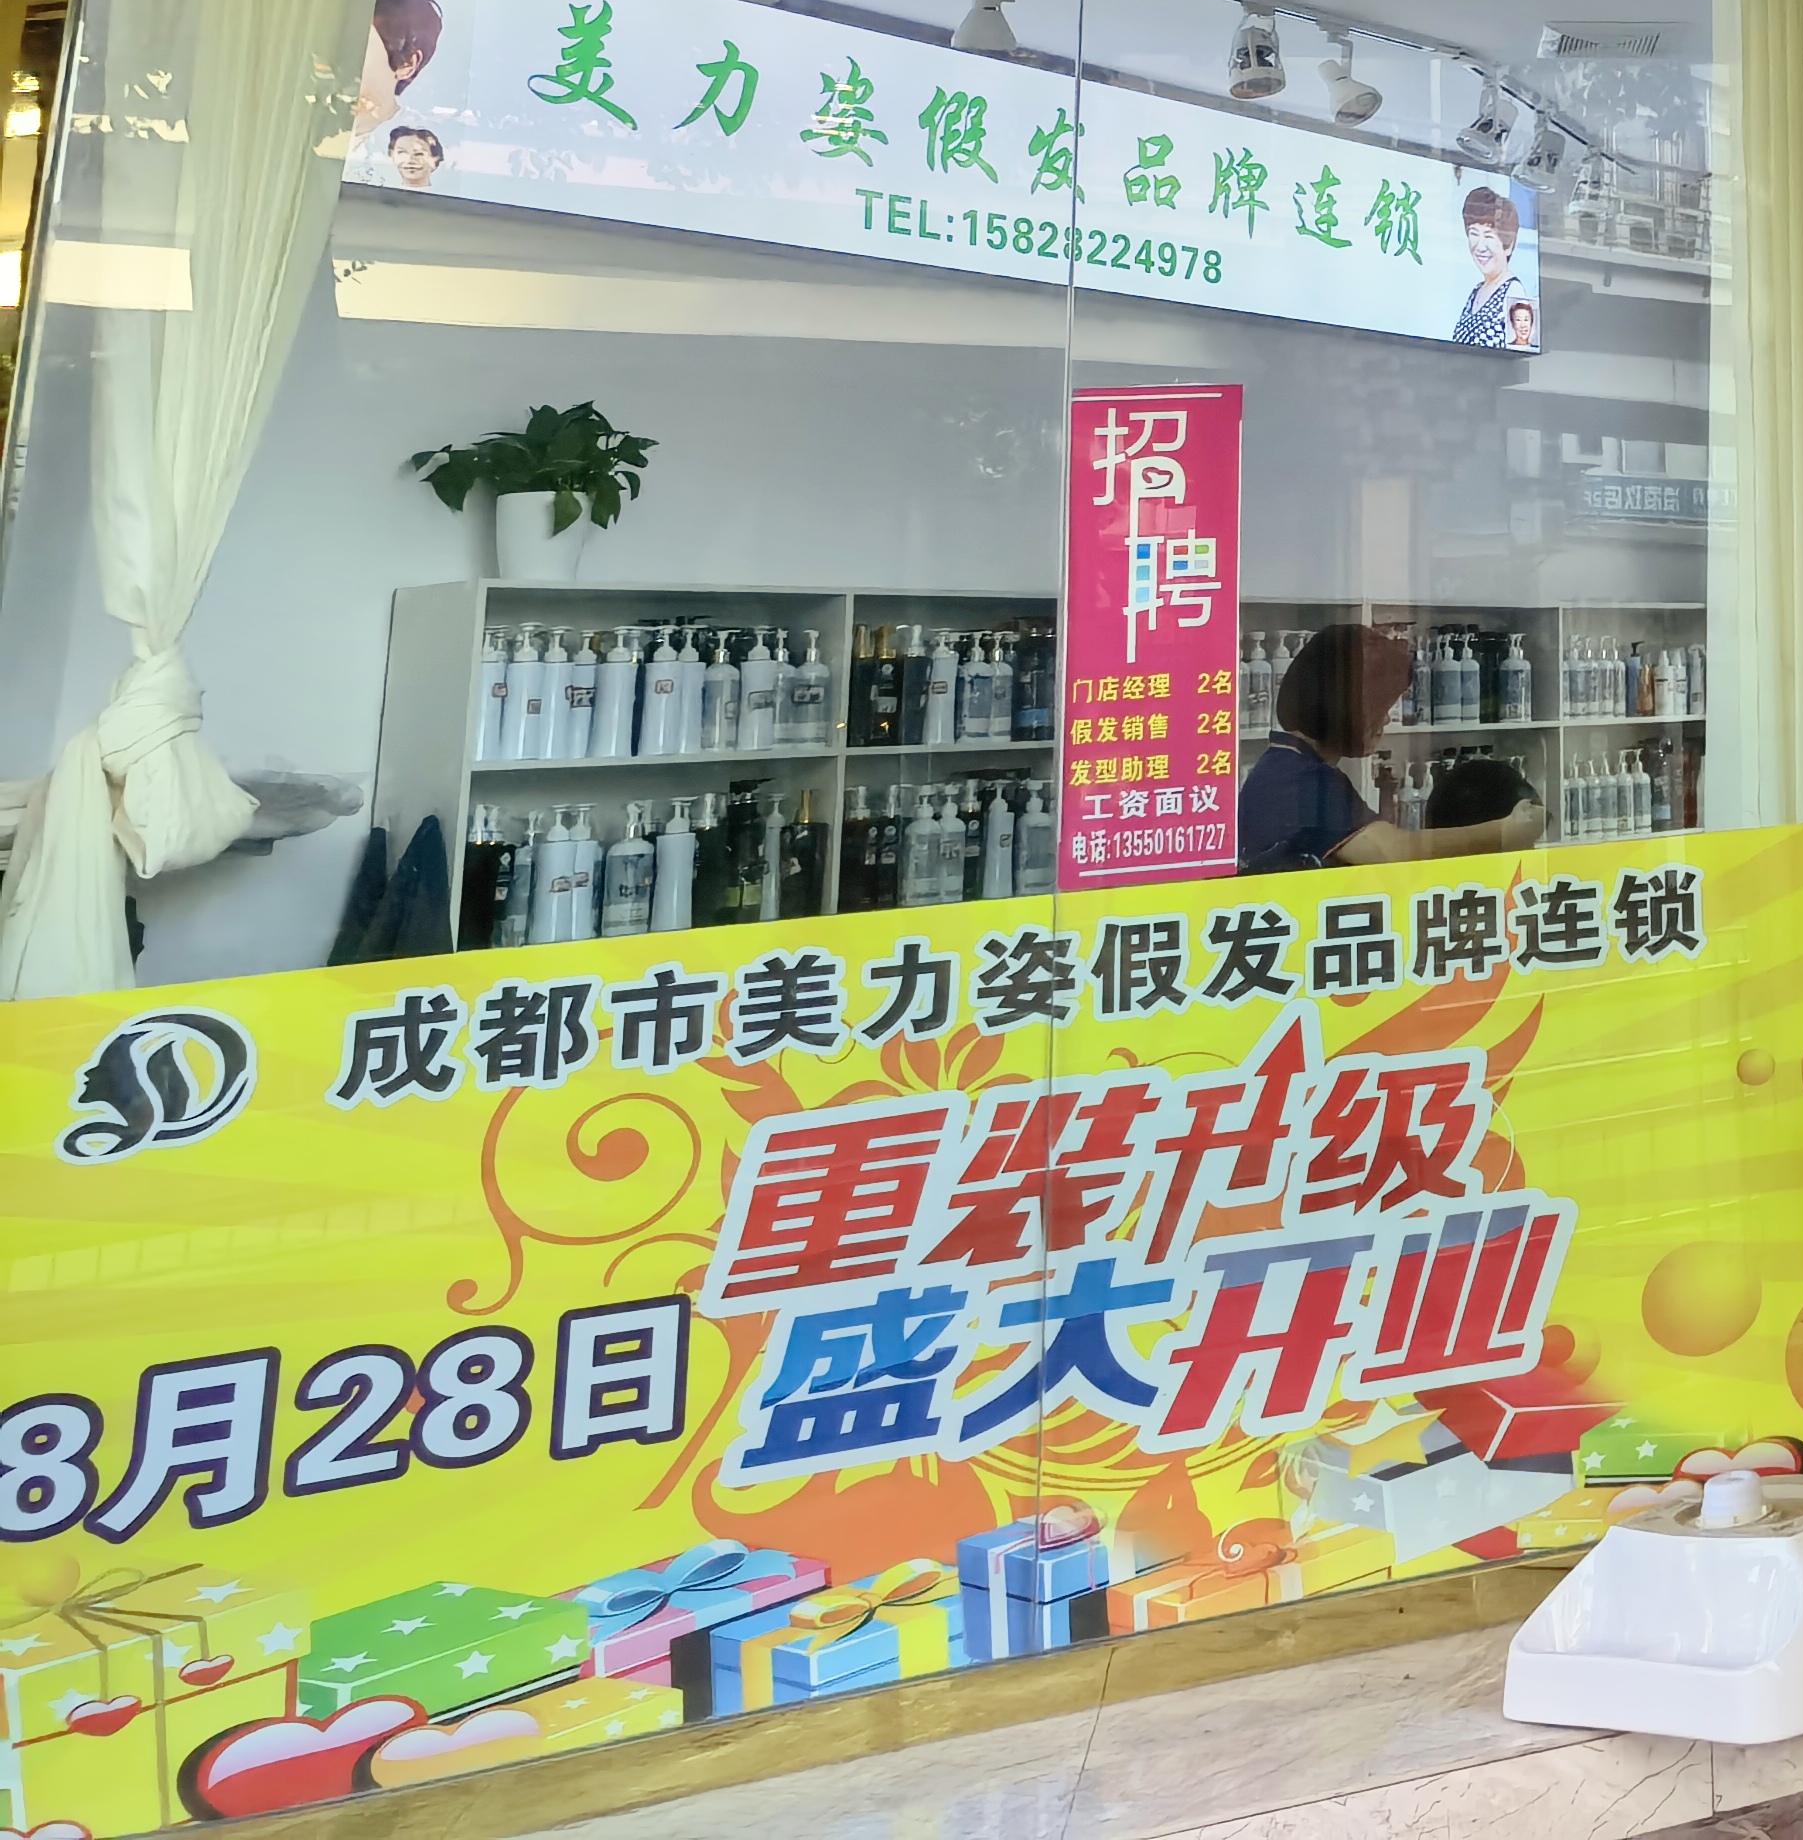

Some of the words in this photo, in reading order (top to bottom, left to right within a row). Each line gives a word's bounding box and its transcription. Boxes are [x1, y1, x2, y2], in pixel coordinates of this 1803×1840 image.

[527, 0, 1423, 265] 美力姿假发品牌连锁
[1093, 407, 1222, 664] 招聘
[1069, 754, 1170, 786] 发型助理
[1196, 749, 1232, 776] 2名
[1070, 713, 1169, 745] 假发销售
[1196, 709, 1232, 735] 2名
[1072, 673, 1171, 703] 门店经理
[1197, 669, 1233, 695] 2名
[1082, 784, 1220, 820] 工资面议
[337, 869, 1700, 1102] 成都市美力姿假发品牌连锁
[722, 1016, 1478, 1298] 重装升级
[0, 1298, 690, 1544] 8月28日
[739, 1204, 1553, 1470] 盛大开业
